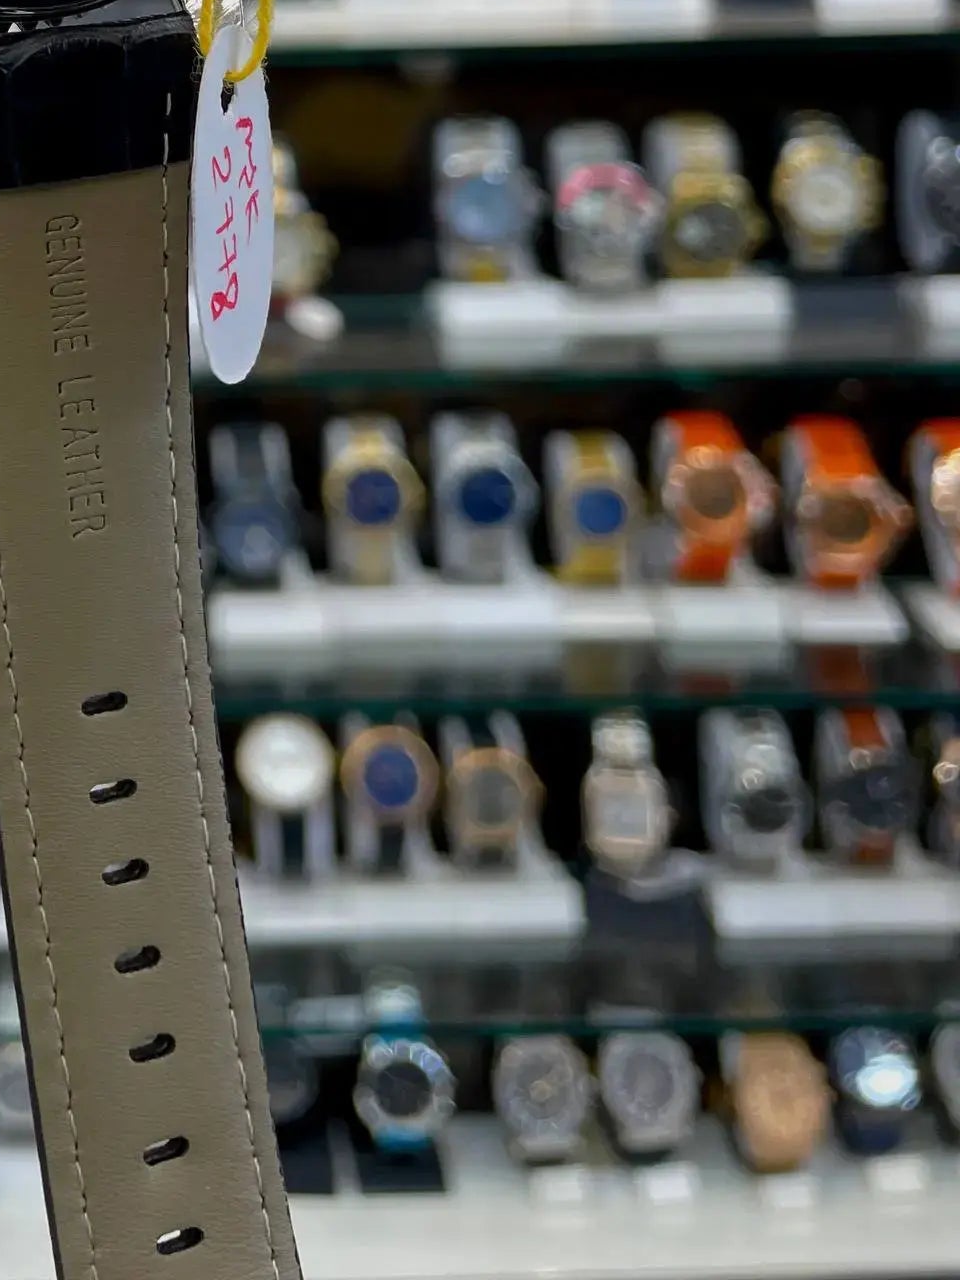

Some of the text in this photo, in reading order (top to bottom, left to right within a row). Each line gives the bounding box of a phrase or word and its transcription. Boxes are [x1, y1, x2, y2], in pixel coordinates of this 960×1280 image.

[210, 146, 239, 322] 2778
[45, 214, 110, 541] GENUINE LEATHER
